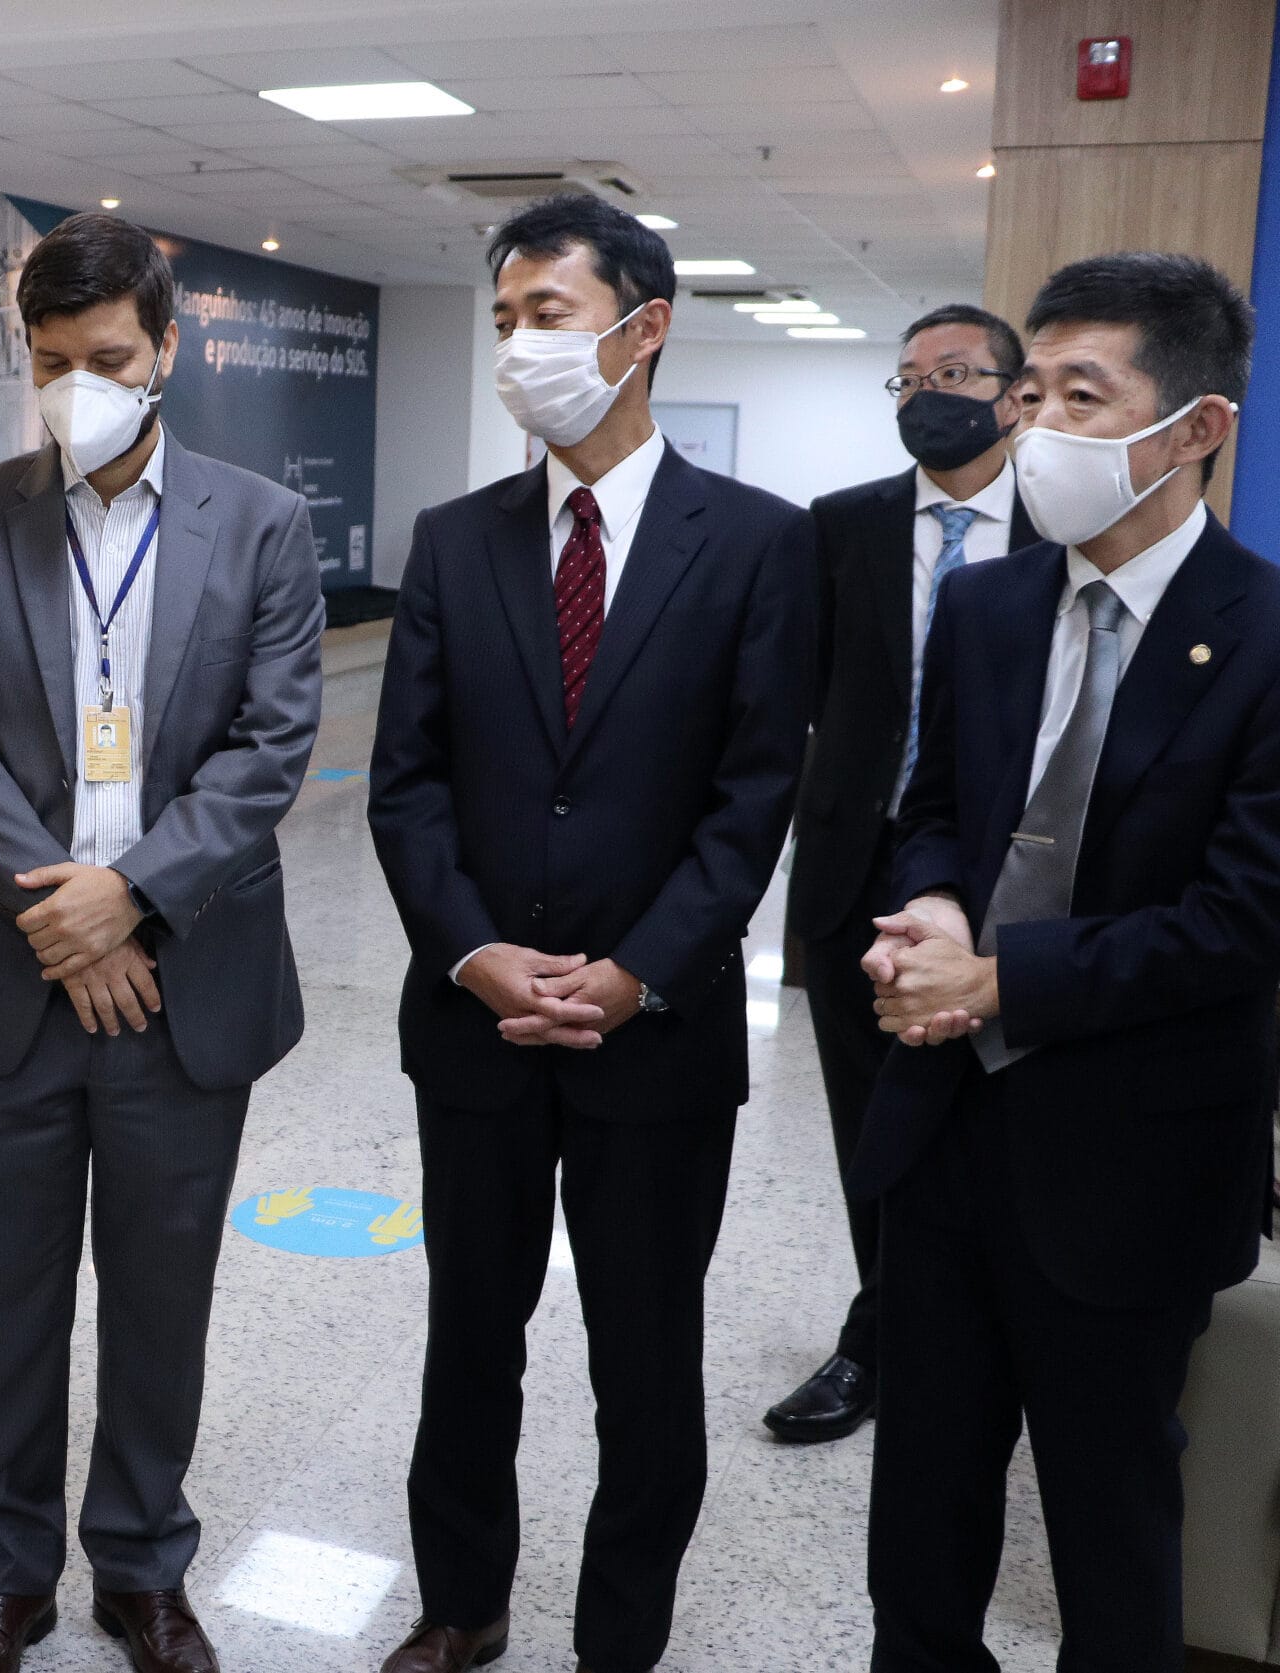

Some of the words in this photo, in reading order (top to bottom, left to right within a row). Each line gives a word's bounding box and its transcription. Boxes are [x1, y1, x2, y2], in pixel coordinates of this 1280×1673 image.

[260, 299, 276, 328] 45
[278, 305, 306, 331] anos
[307, 303, 322, 332] de
[323, 304, 370, 345] inovação
[205, 337, 215, 365] e
[216, 334, 277, 376] produção
[278, 347, 287, 370] a
[288, 342, 329, 380] serviço
[329, 345, 345, 374] do
